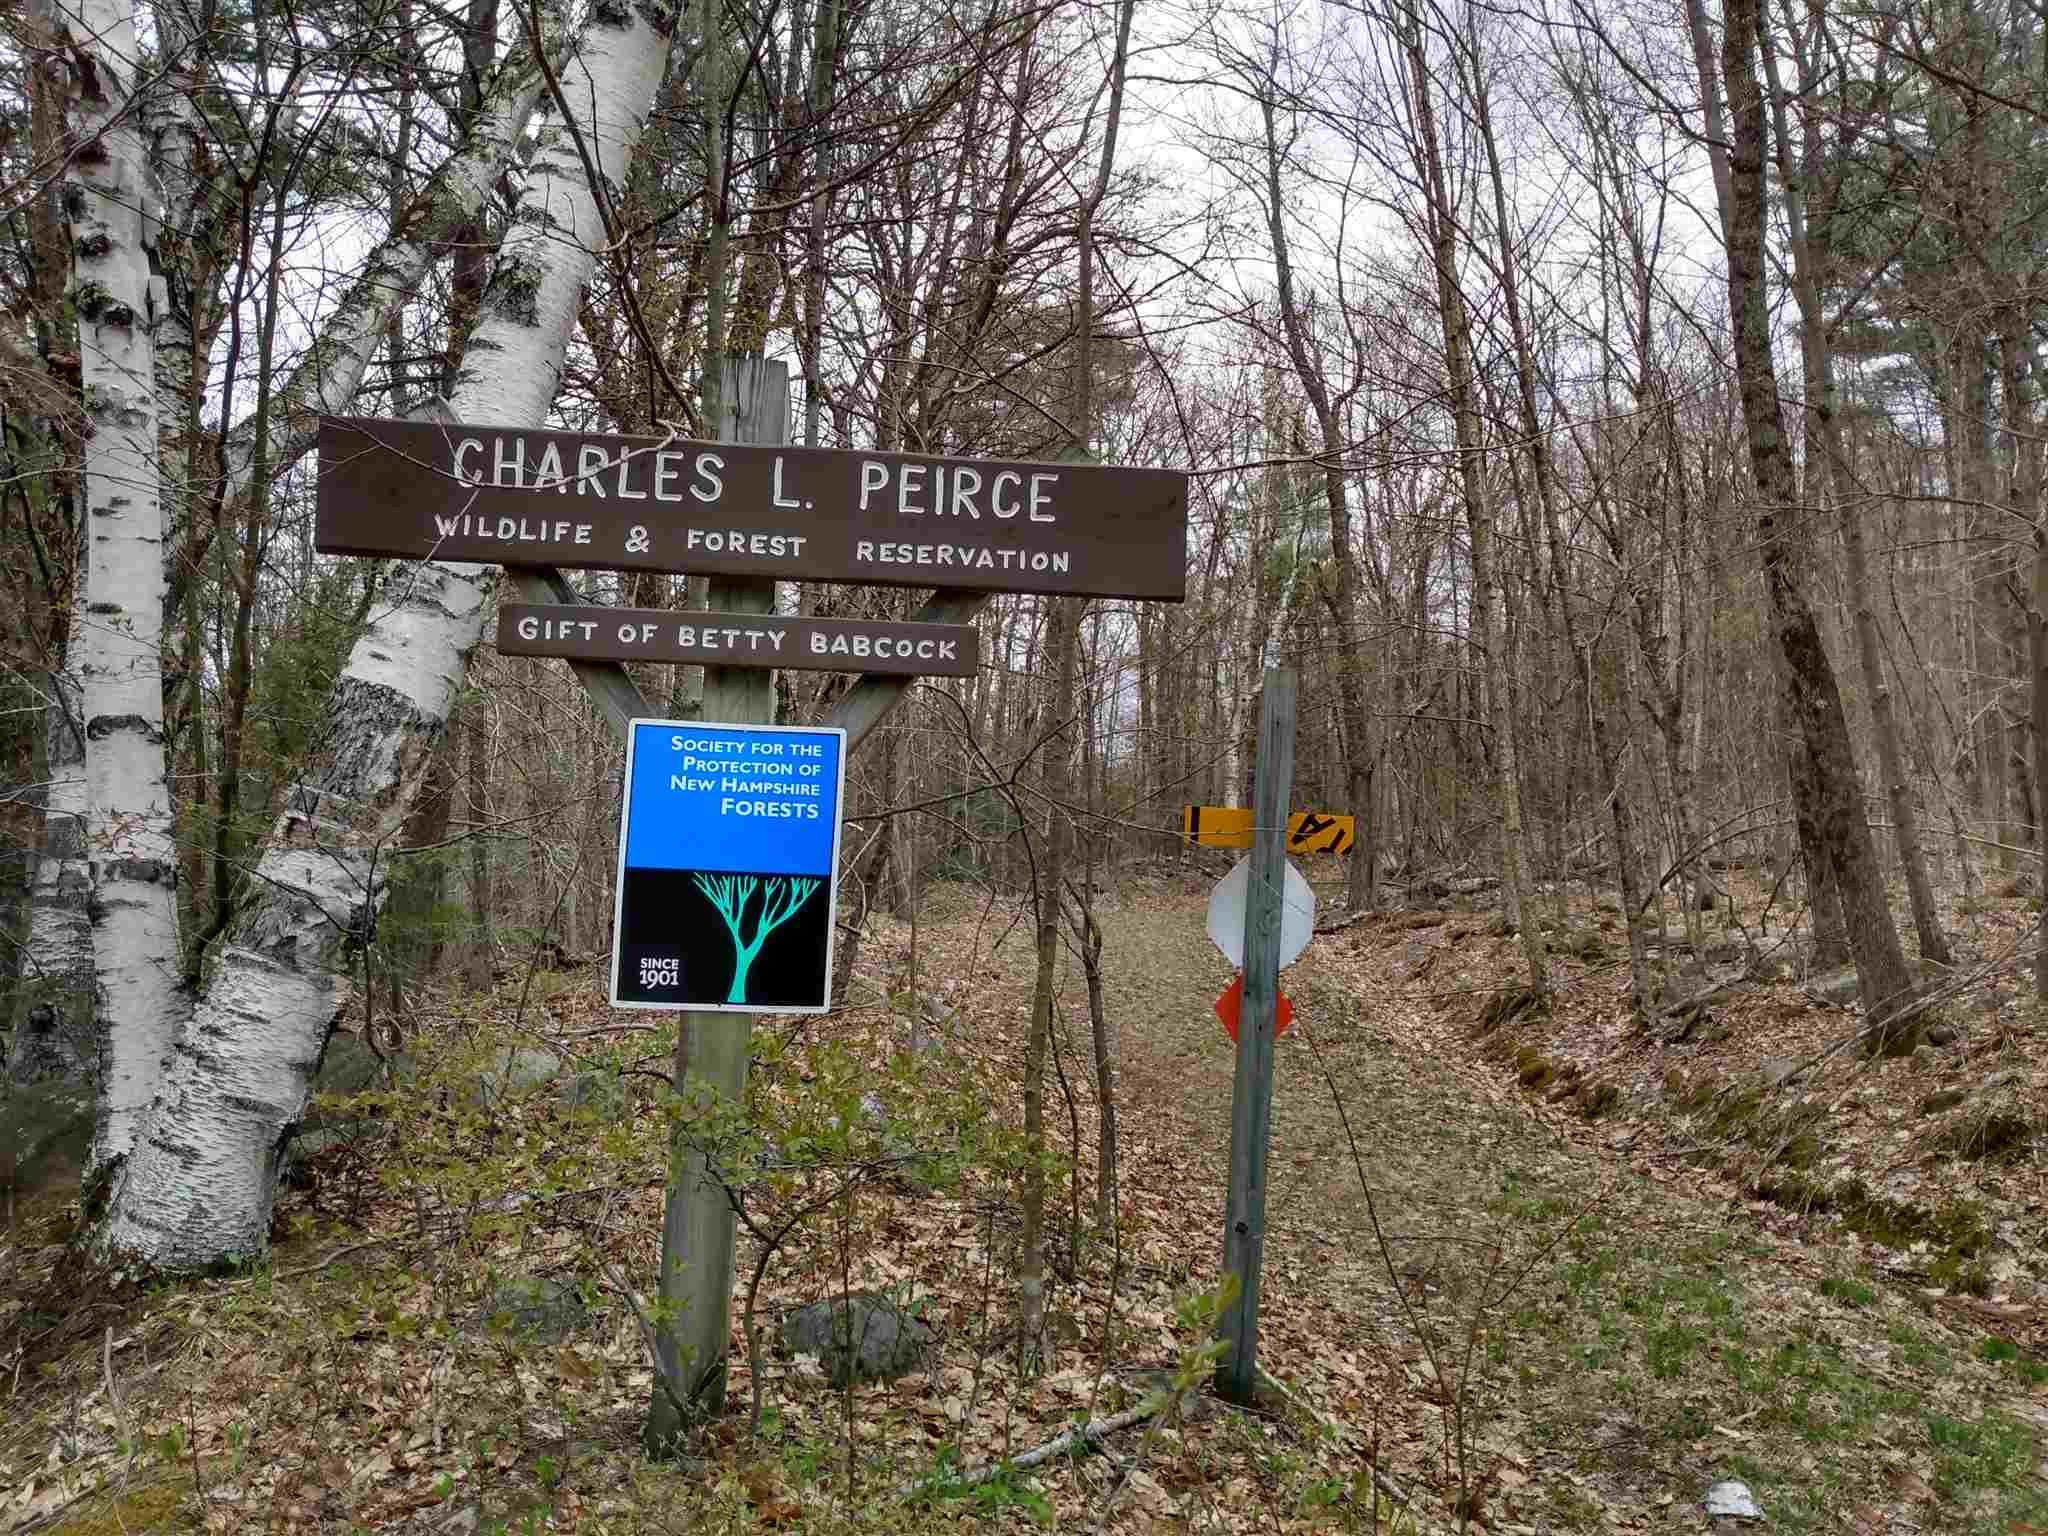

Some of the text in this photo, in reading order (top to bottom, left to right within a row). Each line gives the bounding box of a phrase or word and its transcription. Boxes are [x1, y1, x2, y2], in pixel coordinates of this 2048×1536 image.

[452, 438, 1060, 523] CHARLES L. PEIRCE
[434, 514, 1070, 572] WILDLIFE & FOREST RESERVATION
[518, 616, 958, 660] GIFT OF BETTY BABCOCK
[671, 735, 823, 757] SOCIETY FOR THE
[683, 755, 823, 776] PROTECTION OF
[670, 774, 821, 796] NEW HAMPSHIRE
[720, 798, 819, 819] FORESTS
[640, 957, 680, 970] SINCE
[639, 970, 680, 989] 1901
